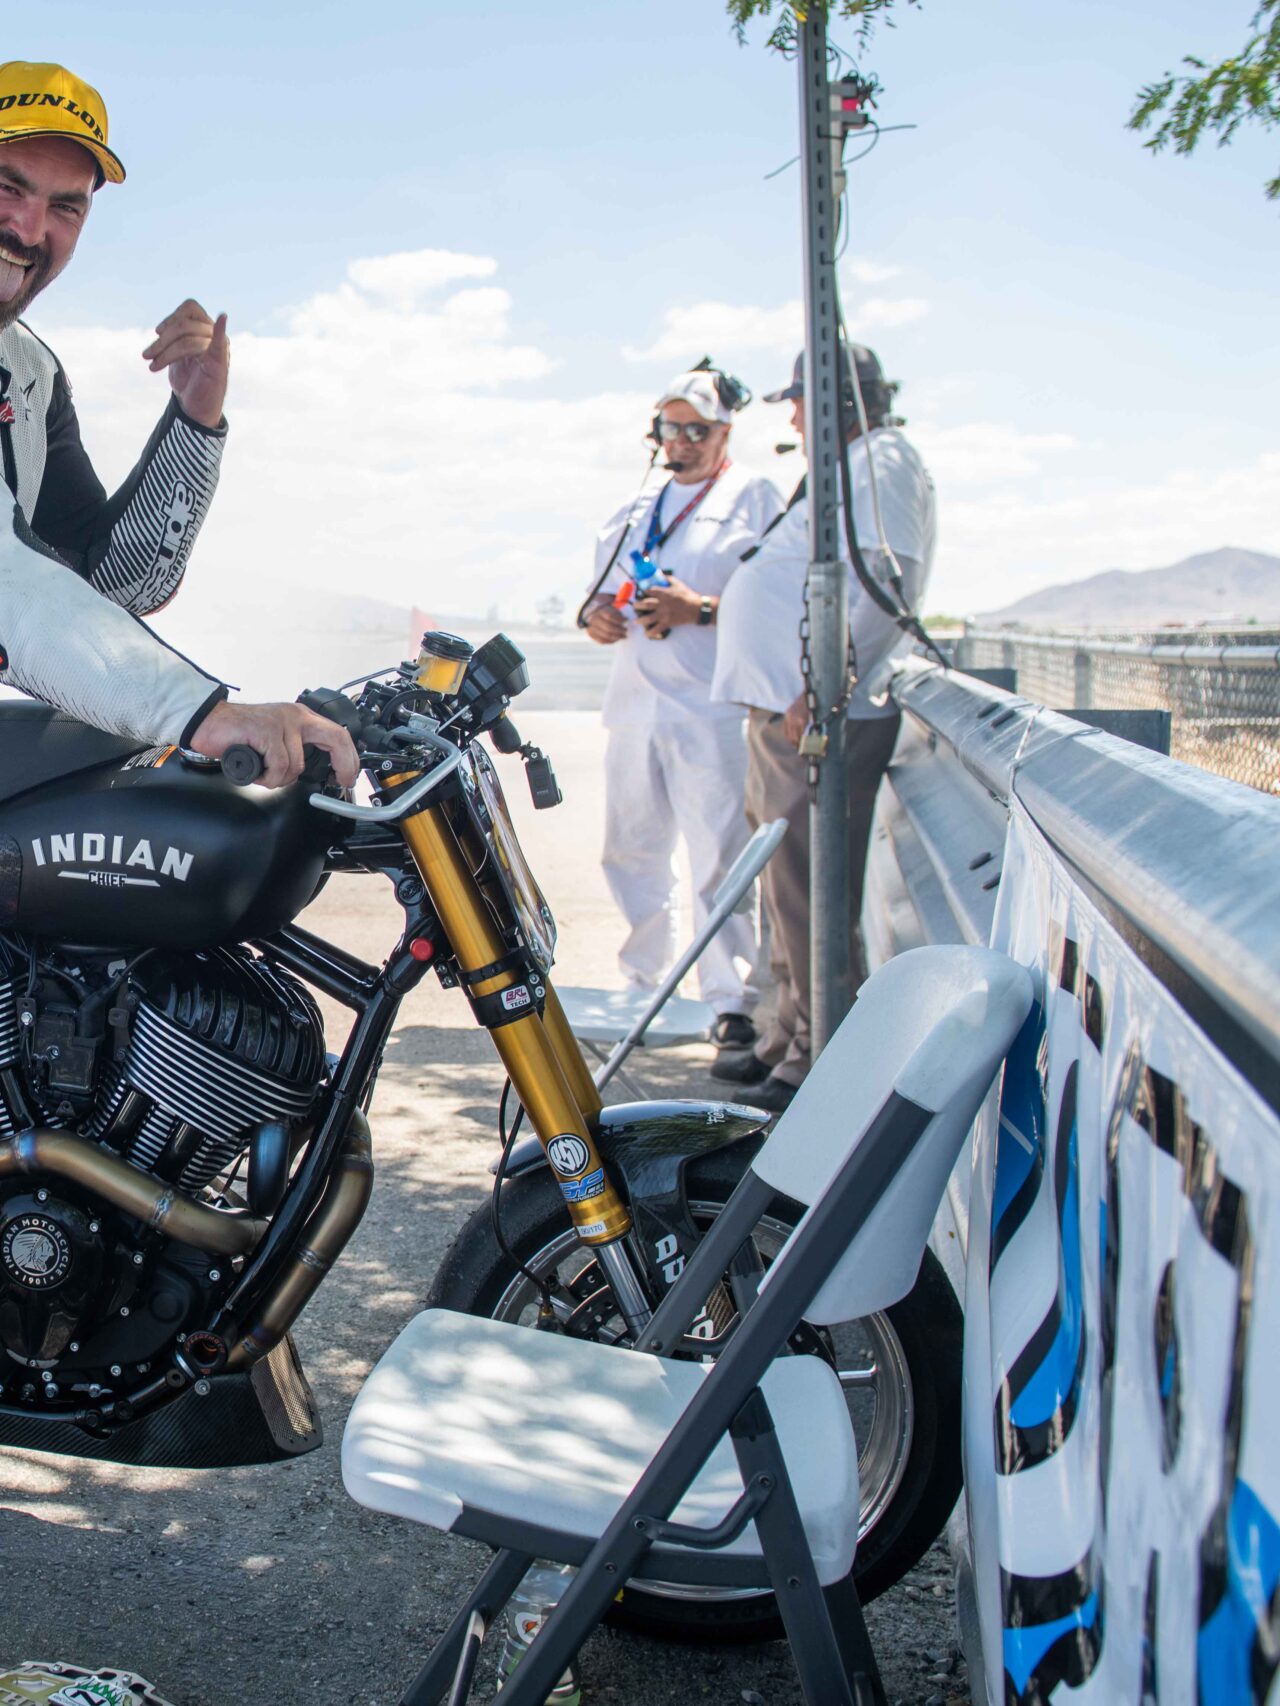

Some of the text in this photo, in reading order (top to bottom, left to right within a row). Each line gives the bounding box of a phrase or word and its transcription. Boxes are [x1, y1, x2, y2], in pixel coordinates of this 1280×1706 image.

[31, 833, 195, 882] INDIAN
[87, 870, 127, 887] CHIEF
[2, 1218, 69, 1276] INDIAN MOTORCYCLE
[22, 1274, 47, 1285] 1901
